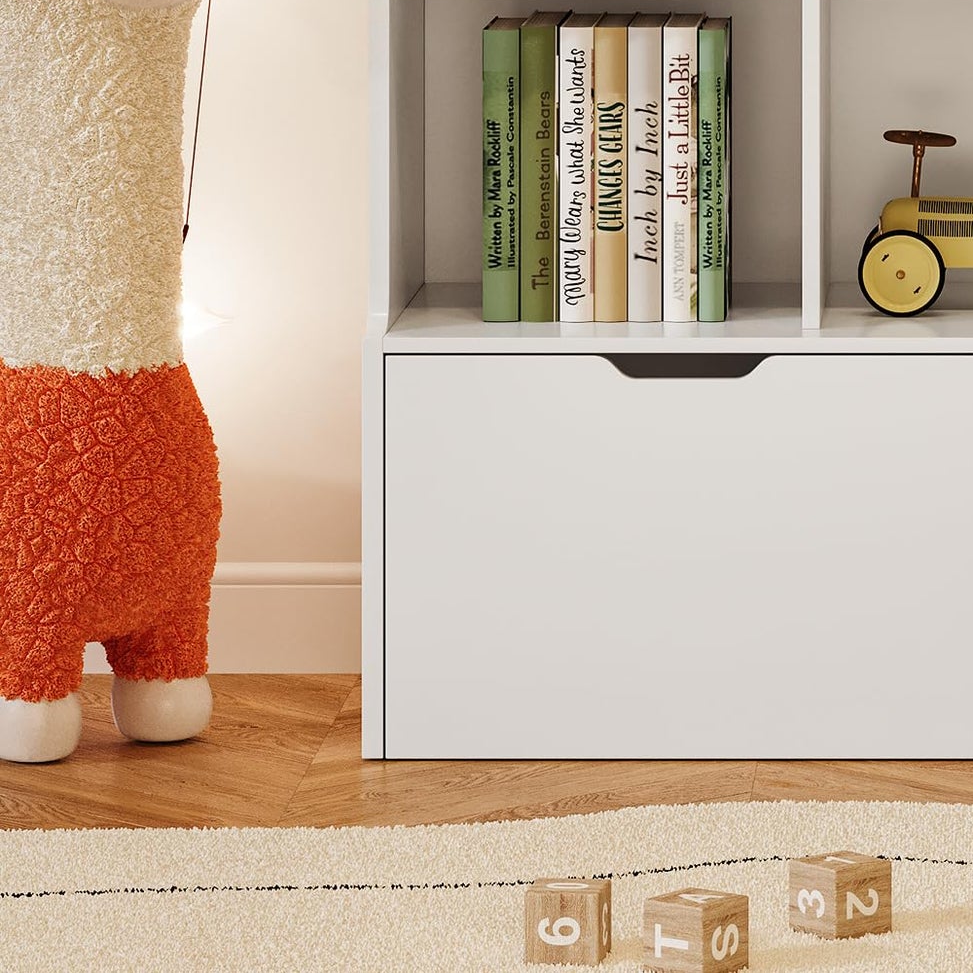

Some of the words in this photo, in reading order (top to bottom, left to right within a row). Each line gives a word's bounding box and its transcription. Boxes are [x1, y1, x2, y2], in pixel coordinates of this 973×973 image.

[564, 48, 586, 104] Wants
[668, 53, 691, 84] Bit
[506, 76, 515, 143] Constantin
[535, 91, 551, 140] Bears
[562, 106, 586, 134] She
[596, 101, 626, 154] GEARS
[634, 100, 659, 157] Inch
[667, 85, 690, 139] Little
[714, 76, 722, 143] Constantin
[486, 119, 501, 167] Rockliff
[566, 139, 586, 184] what
[675, 142, 689, 154] a
[701, 119, 712, 167] Rockliff
[487, 169, 502, 201] Mara
[506, 145, 515, 188] Pascale
[633, 170, 663, 197] by
[666, 161, 689, 205] Just
[702, 169, 712, 201] Mara
[487, 204, 504, 218] by
[506, 190, 517, 205] by
[535, 147, 550, 241] Berenstain
[596, 158, 625, 233] CHANGES
[702, 204, 715, 218] by
[715, 190, 723, 205] by
[506, 208, 515, 268] Illustrated
[560, 190, 587, 243] Wears
[633, 210, 658, 265] Inch
[487, 222, 502, 269] Written
[672, 221, 686, 275] TOMPERT
[702, 222, 713, 269] Written
[531, 257, 550, 290] The
[563, 248, 587, 306] Mary
[672, 276, 685, 302] ANN
[797, 888, 825, 919] 3
[846, 888, 879, 920] 2
[537, 916, 581, 947] 6
[654, 923, 689, 959] T
[711, 923, 740, 962] S
